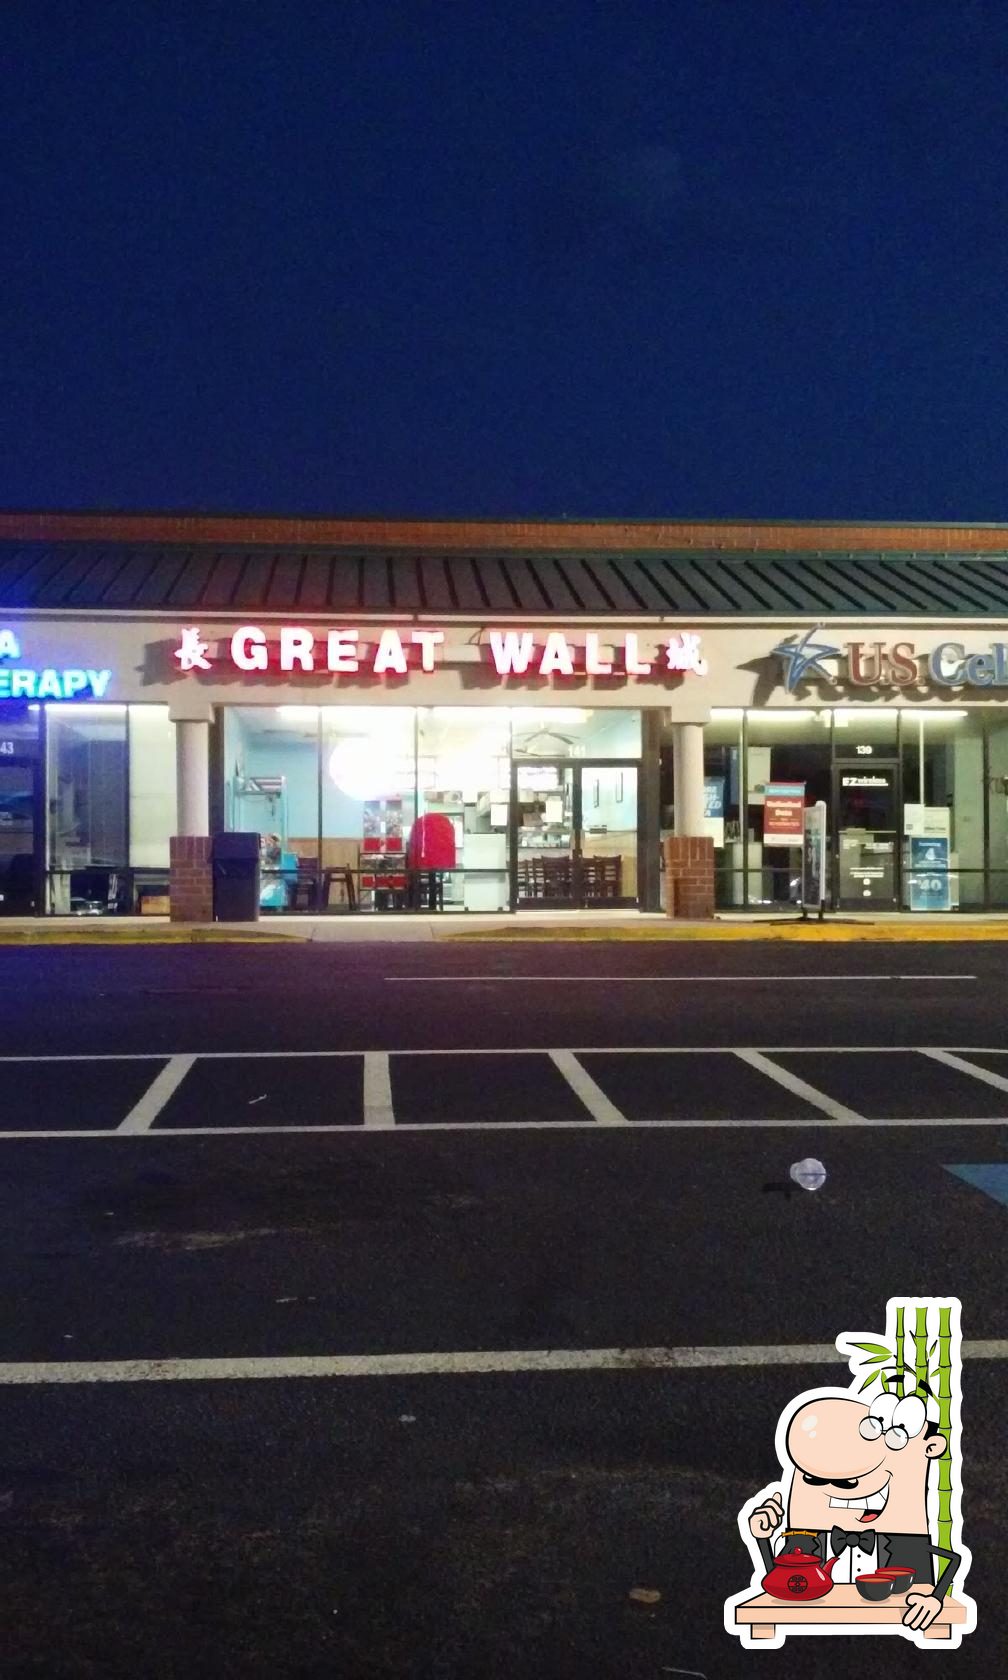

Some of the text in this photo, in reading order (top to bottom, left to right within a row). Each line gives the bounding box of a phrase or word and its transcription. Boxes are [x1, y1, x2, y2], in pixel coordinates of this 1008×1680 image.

[230, 626, 444, 673] GREAT
[489, 631, 651, 675] WALL
[845, 641, 926, 687] U.S.
[855, 744, 873, 755] 139
